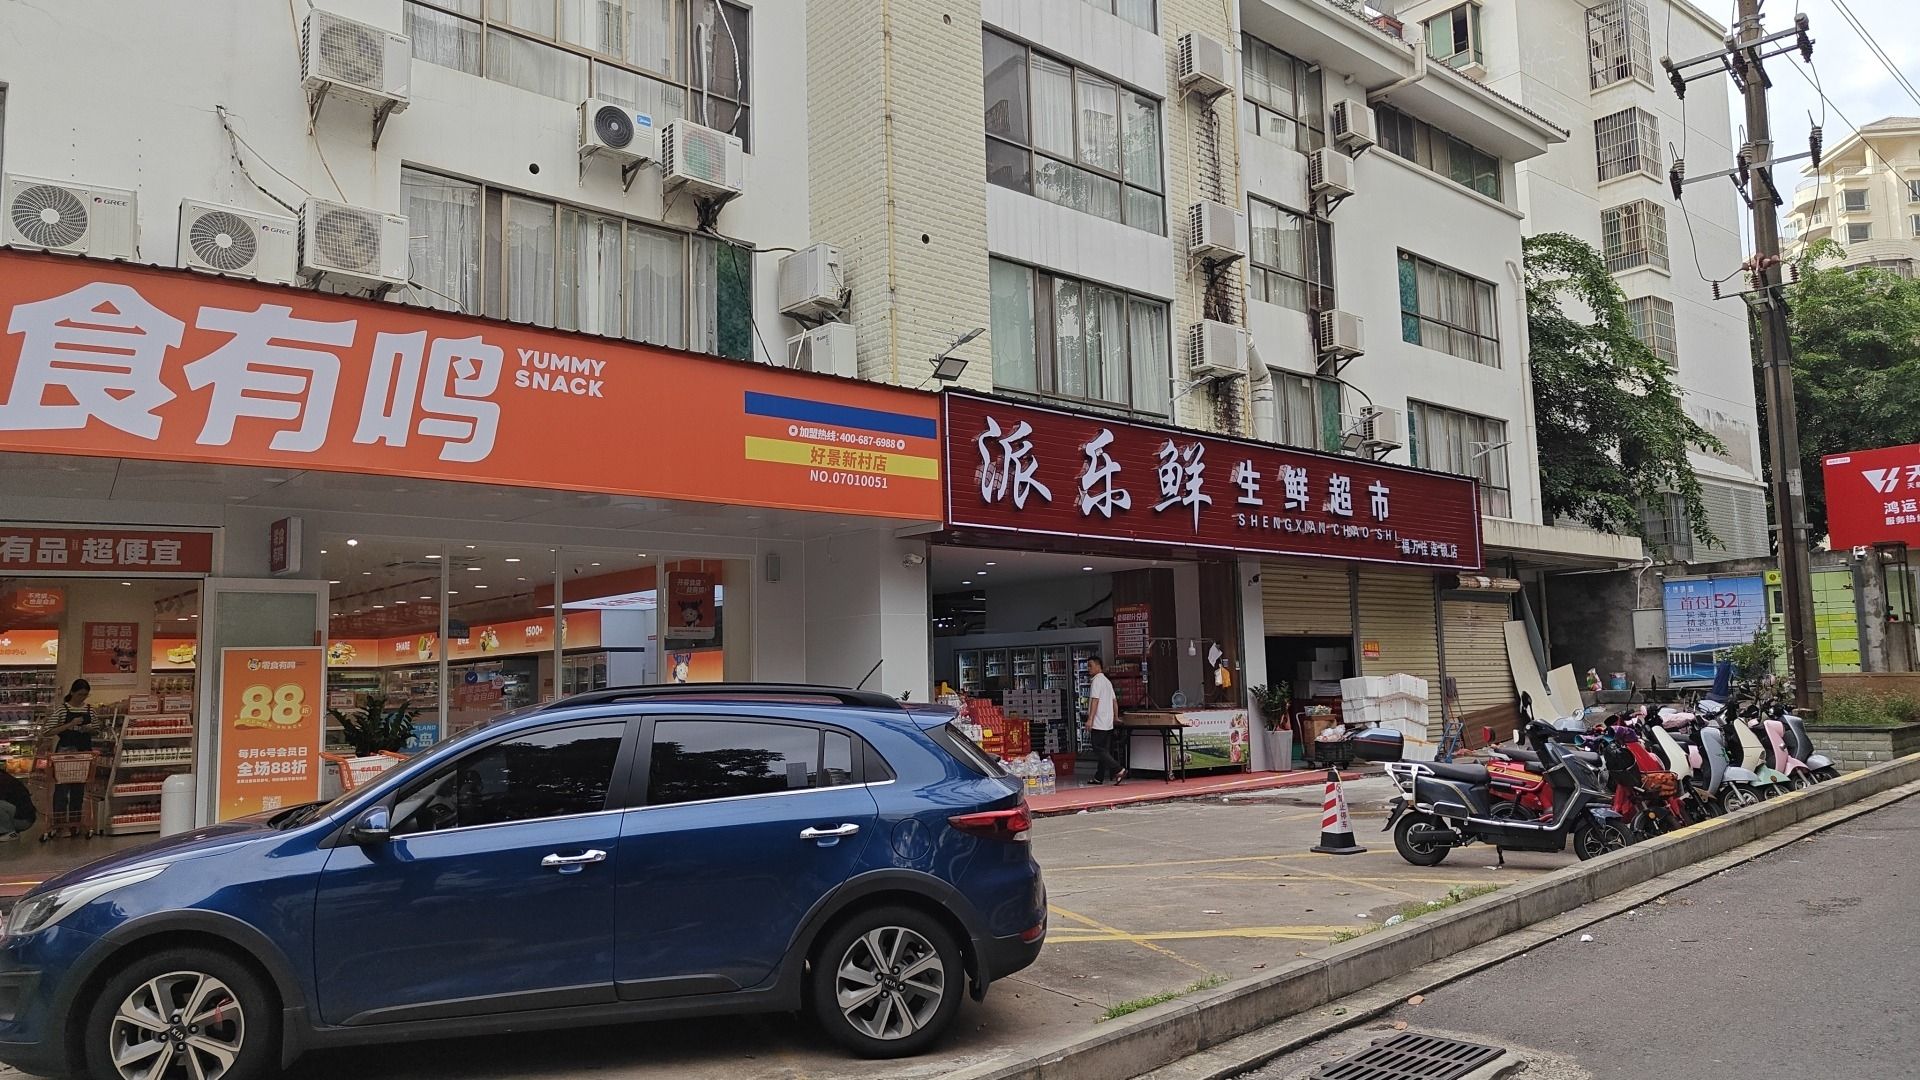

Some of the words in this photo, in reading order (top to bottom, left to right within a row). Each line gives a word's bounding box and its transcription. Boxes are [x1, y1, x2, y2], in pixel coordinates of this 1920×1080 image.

[103, 200, 129, 208] GREE
[270, 227, 293, 236] GREE
[516, 347, 607, 377] YUMMY
[514, 369, 605, 398] SNACK
[810, 446, 888, 472] 好景新村店
[810, 470, 888, 489] NO.07010051
[979, 415, 1213, 534] 派乐鲜
[1234, 459, 1391, 522] 生鲜超市
[1884, 499, 1920, 514] 鸿运
[1333, 523, 1370, 538] CHAO
[80, 538, 182, 565] 超便宜
[241, 683, 304, 725] 88
[238, 746, 308, 759] 每月6号会员日
[237, 759, 308, 777] 全场88折
[885, 978, 896, 987] KIA
[171, 1027, 184, 1040] KIA
